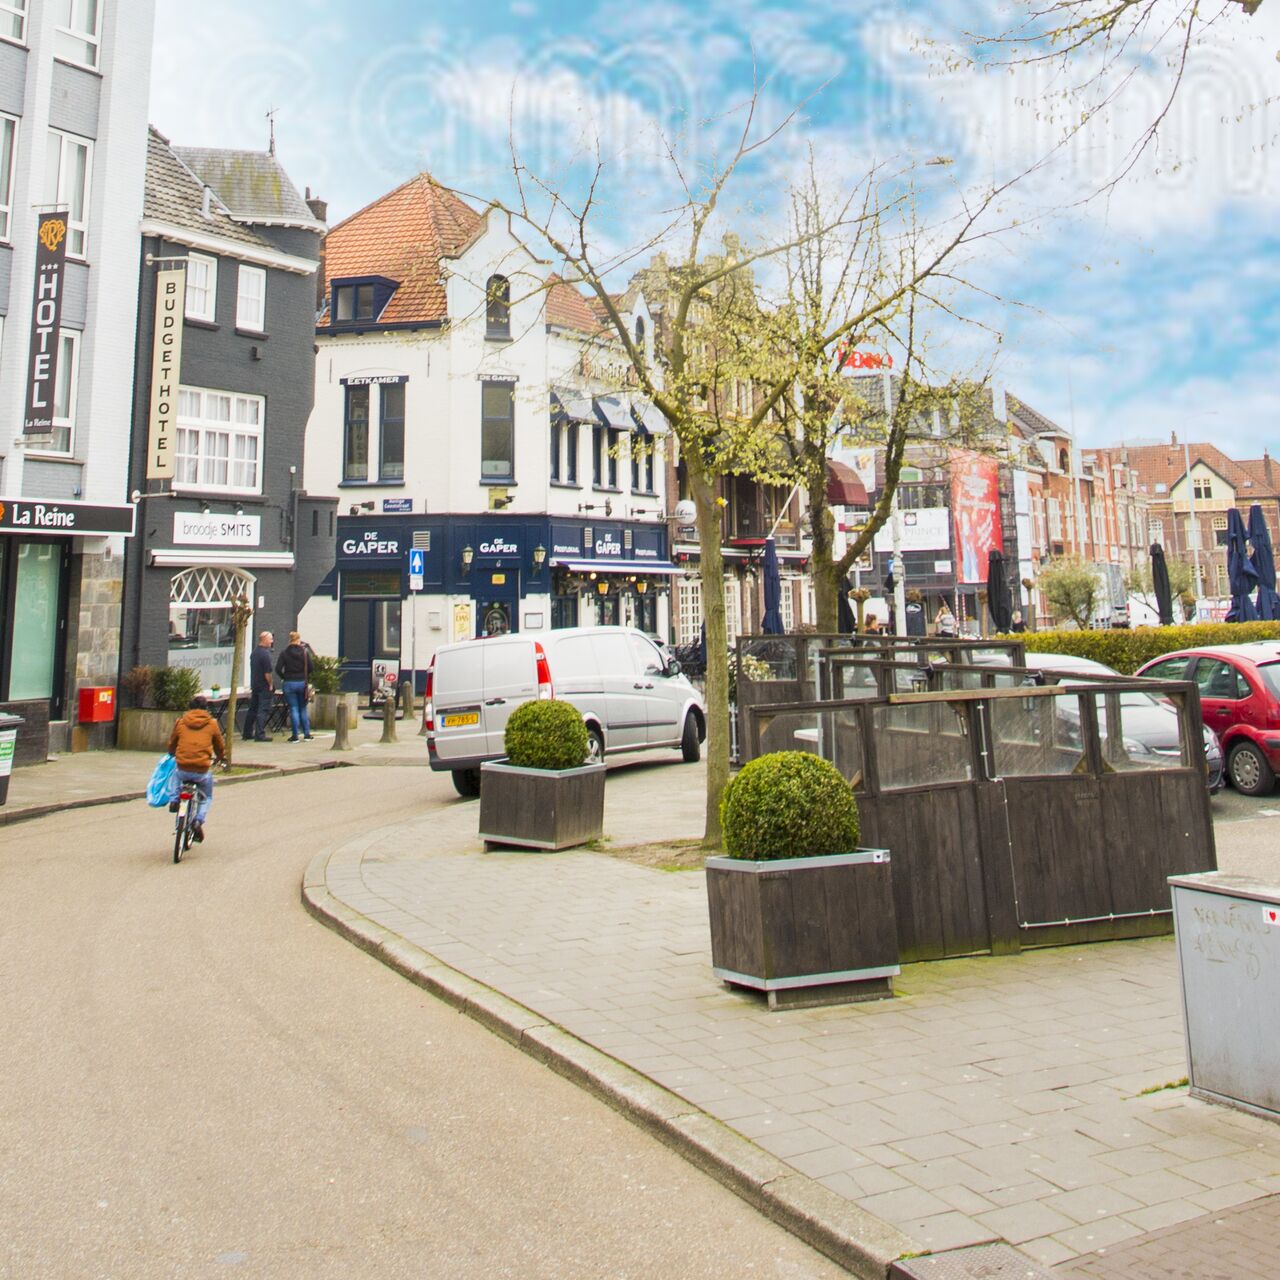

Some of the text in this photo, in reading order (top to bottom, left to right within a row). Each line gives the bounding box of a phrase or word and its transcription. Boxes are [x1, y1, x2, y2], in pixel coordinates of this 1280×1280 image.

[32, 272, 58, 408] HOTEL
[347, 376, 400, 385] EETKAMER
[491, 374, 518, 382] GAPER
[12, 503, 30, 525] La
[34, 504, 76, 527] Reine
[183, 521, 252, 540] broodje SMITS
[364, 531, 378, 541] DE
[342, 540, 399, 554] GAPER
[479, 543, 518, 553] GAPER
[595, 540, 621, 555] GAPER
